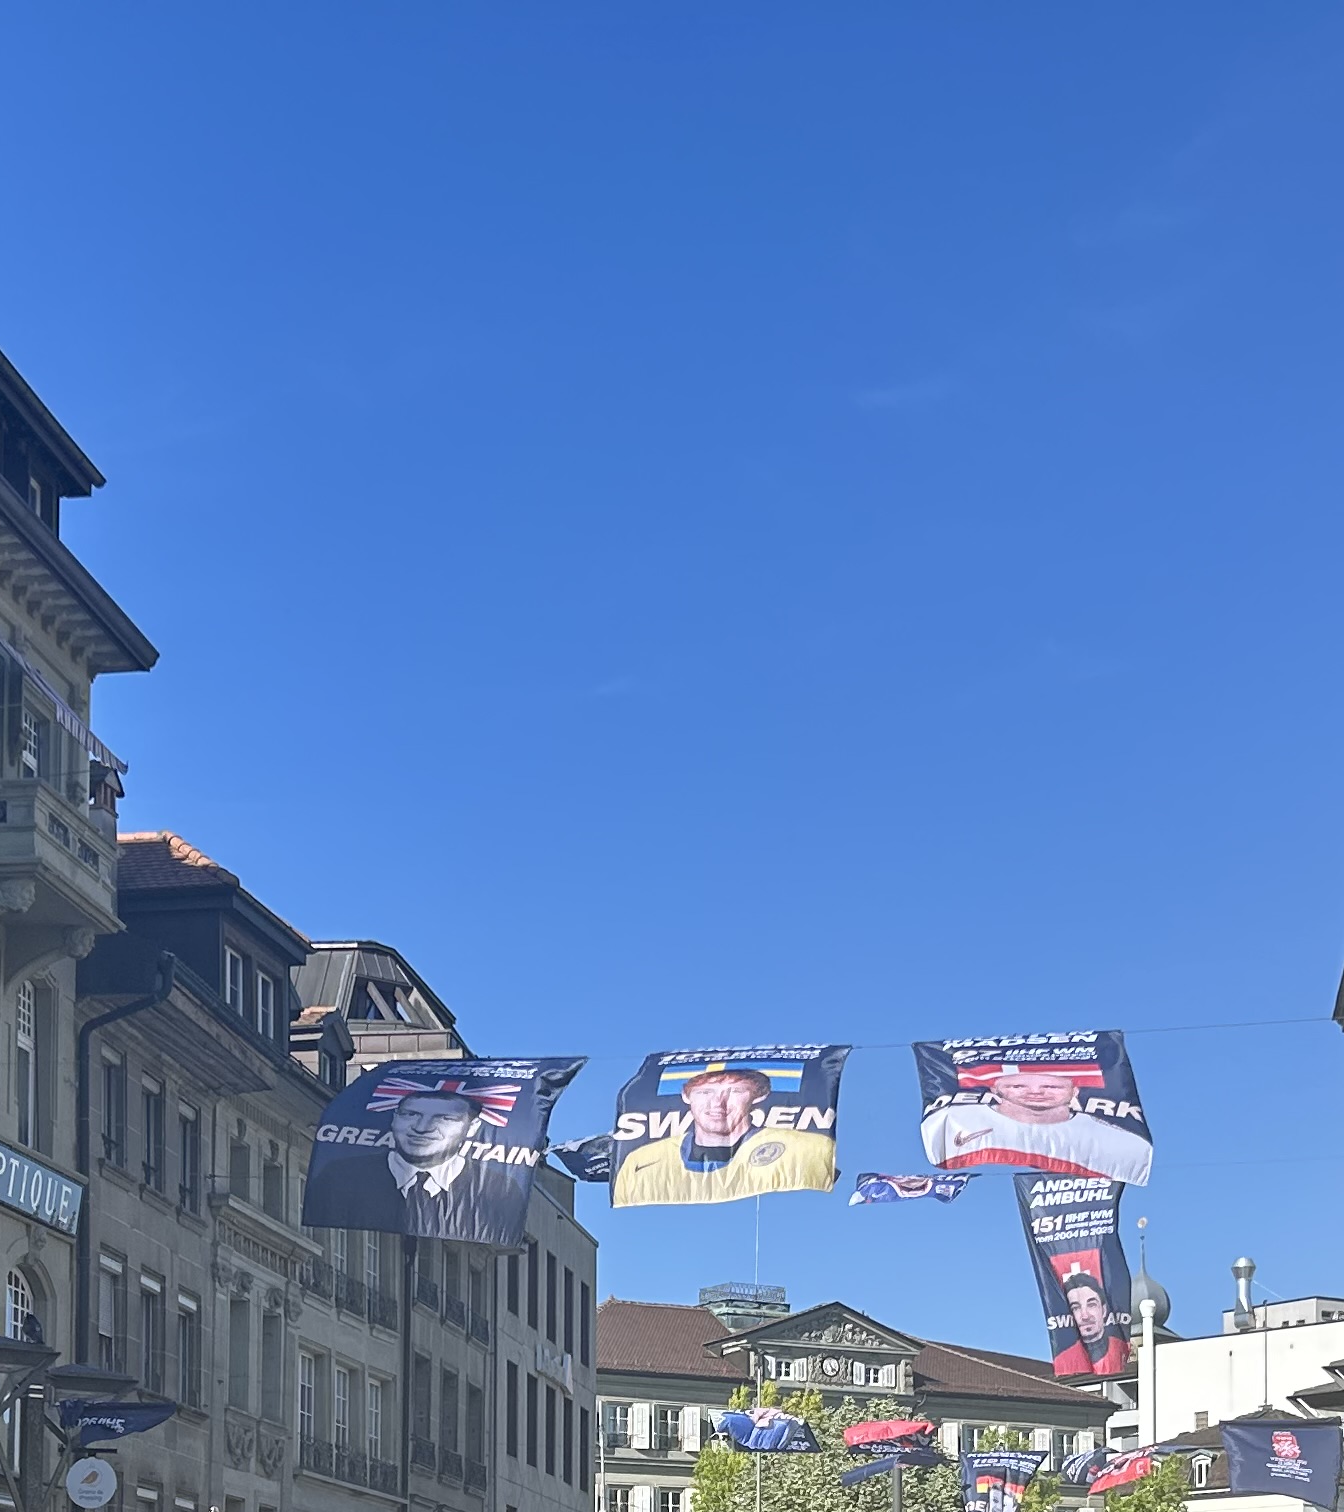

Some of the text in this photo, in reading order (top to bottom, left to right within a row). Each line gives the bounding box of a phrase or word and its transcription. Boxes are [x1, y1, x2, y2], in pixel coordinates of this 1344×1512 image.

[613, 1106, 836, 1141] SWEN
[315, 1125, 540, 1168] GREA ITAIN
[1030, 1178, 1112, 1195] ANDRES
[1031, 1215, 1064, 1235] 151
[1090, 1208, 1114, 1219] WM
